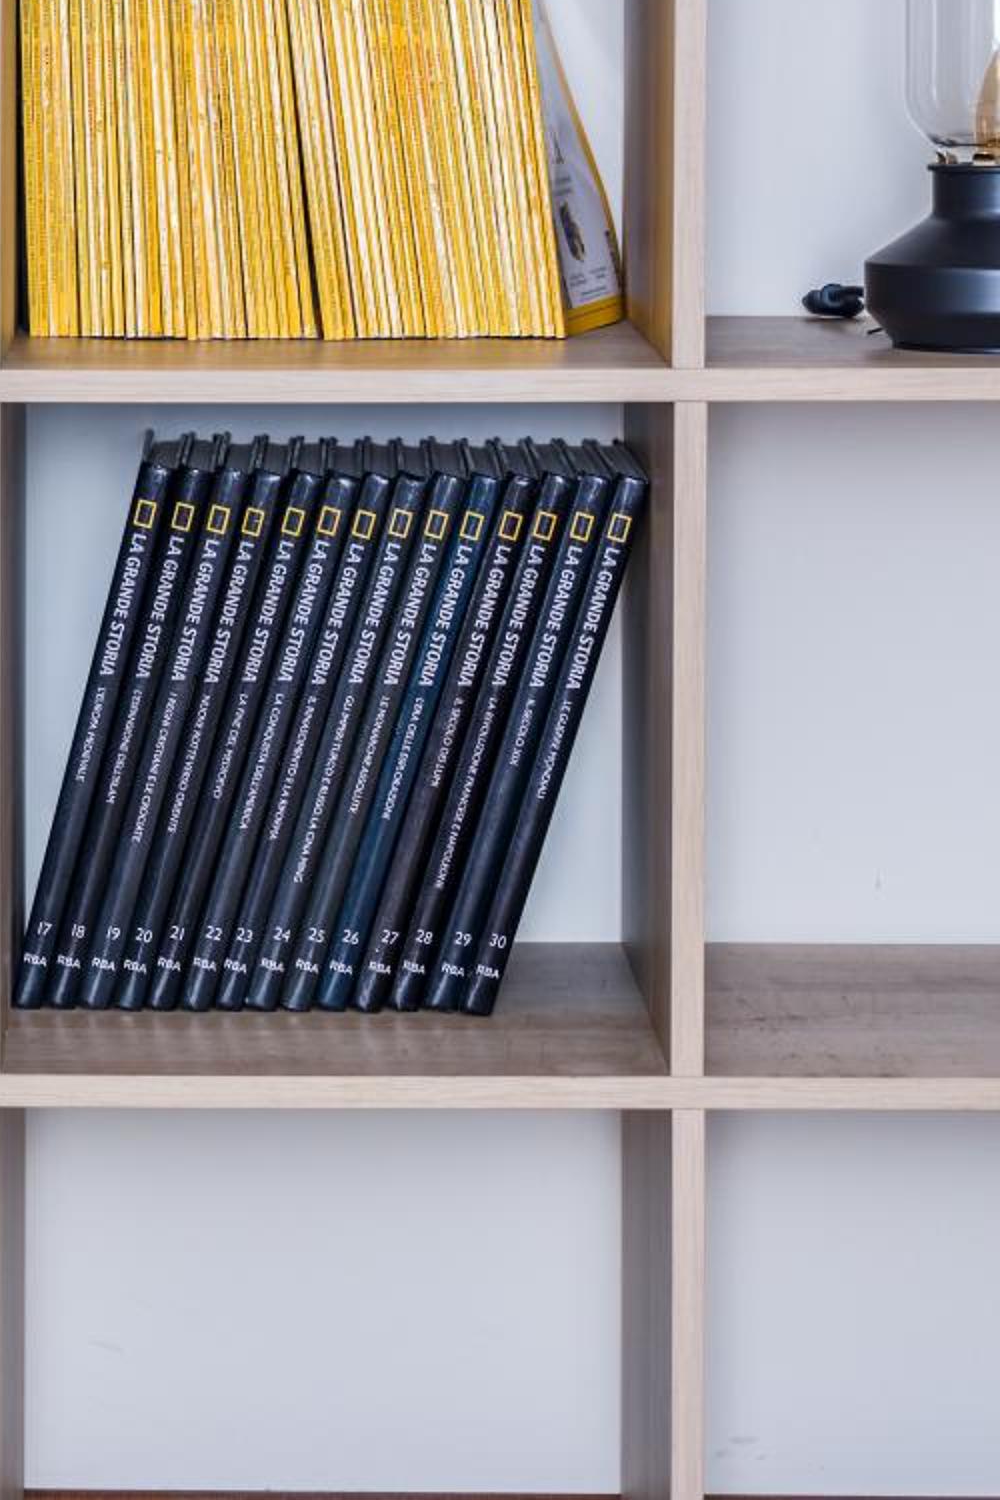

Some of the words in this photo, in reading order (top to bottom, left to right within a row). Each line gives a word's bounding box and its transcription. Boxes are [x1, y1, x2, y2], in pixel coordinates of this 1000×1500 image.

[129, 532, 147, 553] LA
[166, 535, 185, 556] LA
[201, 538, 220, 559] LA
[236, 540, 255, 561] LA
[276, 539, 295, 561] LA
[311, 539, 331, 560] LA
[346, 543, 365, 563] LA
[383, 541, 401, 563] LA
[419, 543, 437, 563] LA
[454, 544, 473, 565] LA
[493, 544, 512, 565] LA
[527, 544, 546, 565] LA
[564, 545, 583, 566] LA
[601, 546, 621, 567] LA
[113, 556, 141, 619] GRANDE
[150, 559, 179, 622] GRANDE
[185, 561, 214, 625] GRANDE
[219, 564, 249, 627] GRANDE
[257, 563, 287, 626] GRANDE
[293, 563, 323, 625] GRANDE
[327, 566, 358, 629] GRANDE
[364, 565, 395, 628] GRANDE
[400, 566, 431, 629] GRANDE
[435, 567, 466, 630] GRANDE
[473, 566, 505, 630] GRANDE
[508, 567, 539, 630] GRANDE
[545, 568, 576, 631] GRANDE
[582, 568, 613, 633] GRANDE
[99, 620, 125, 676] STORIA
[135, 623, 162, 679] STORIA
[171, 625, 198, 681] STORIA
[203, 628, 231, 683] STORIA
[241, 627, 270, 682] STORIA
[277, 627, 305, 682] STORIA
[311, 629, 339, 685] STORIA
[348, 628, 377, 684] STORIA
[383, 630, 412, 685] STORIA
[418, 631, 447, 686] STORIA
[457, 631, 486, 687] STORIA
[491, 631, 520, 687] STORIA
[528, 632, 557, 688] STORIA
[565, 633, 595, 690] STORIA
[36, 921, 53, 937] 17
[71, 923, 86, 942] 18
[105, 925, 121, 941] 19
[135, 927, 153, 944] 20
[169, 925, 185, 941] 21
[205, 924, 223, 942] 22
[235, 926, 254, 943] 23
[272, 925, 291, 943] 24
[307, 926, 326, 944] 25
[341, 928, 359, 945] 26
[380, 928, 400, 945] 27
[414, 928, 434, 945] 28
[453, 930, 473, 947] 29
[488, 932, 507, 949] 30
[193, 957, 216, 973] RBA
